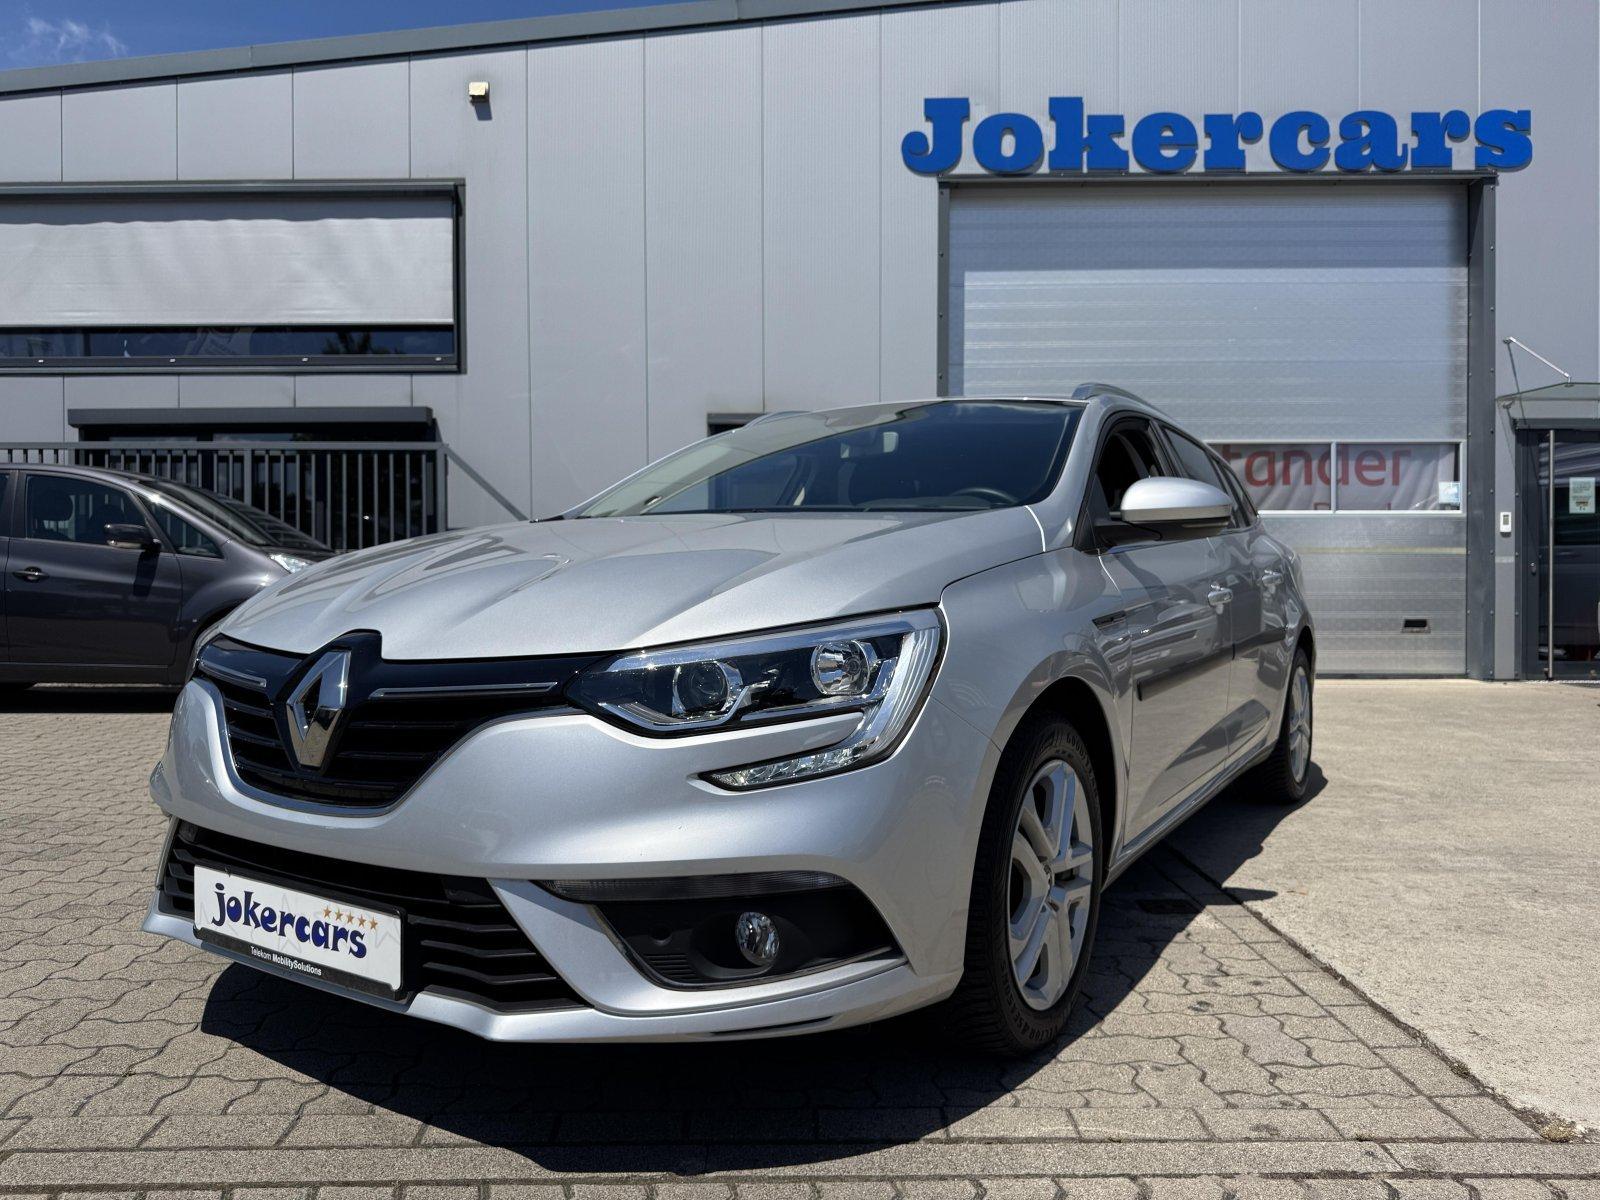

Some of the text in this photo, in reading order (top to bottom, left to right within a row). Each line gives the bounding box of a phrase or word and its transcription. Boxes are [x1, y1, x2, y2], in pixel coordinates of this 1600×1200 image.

[901, 97, 1532, 175] Jokercars
[211, 882, 368, 959] jokercars
[250, 945, 322, 976] Telekom MobilitySolutions
